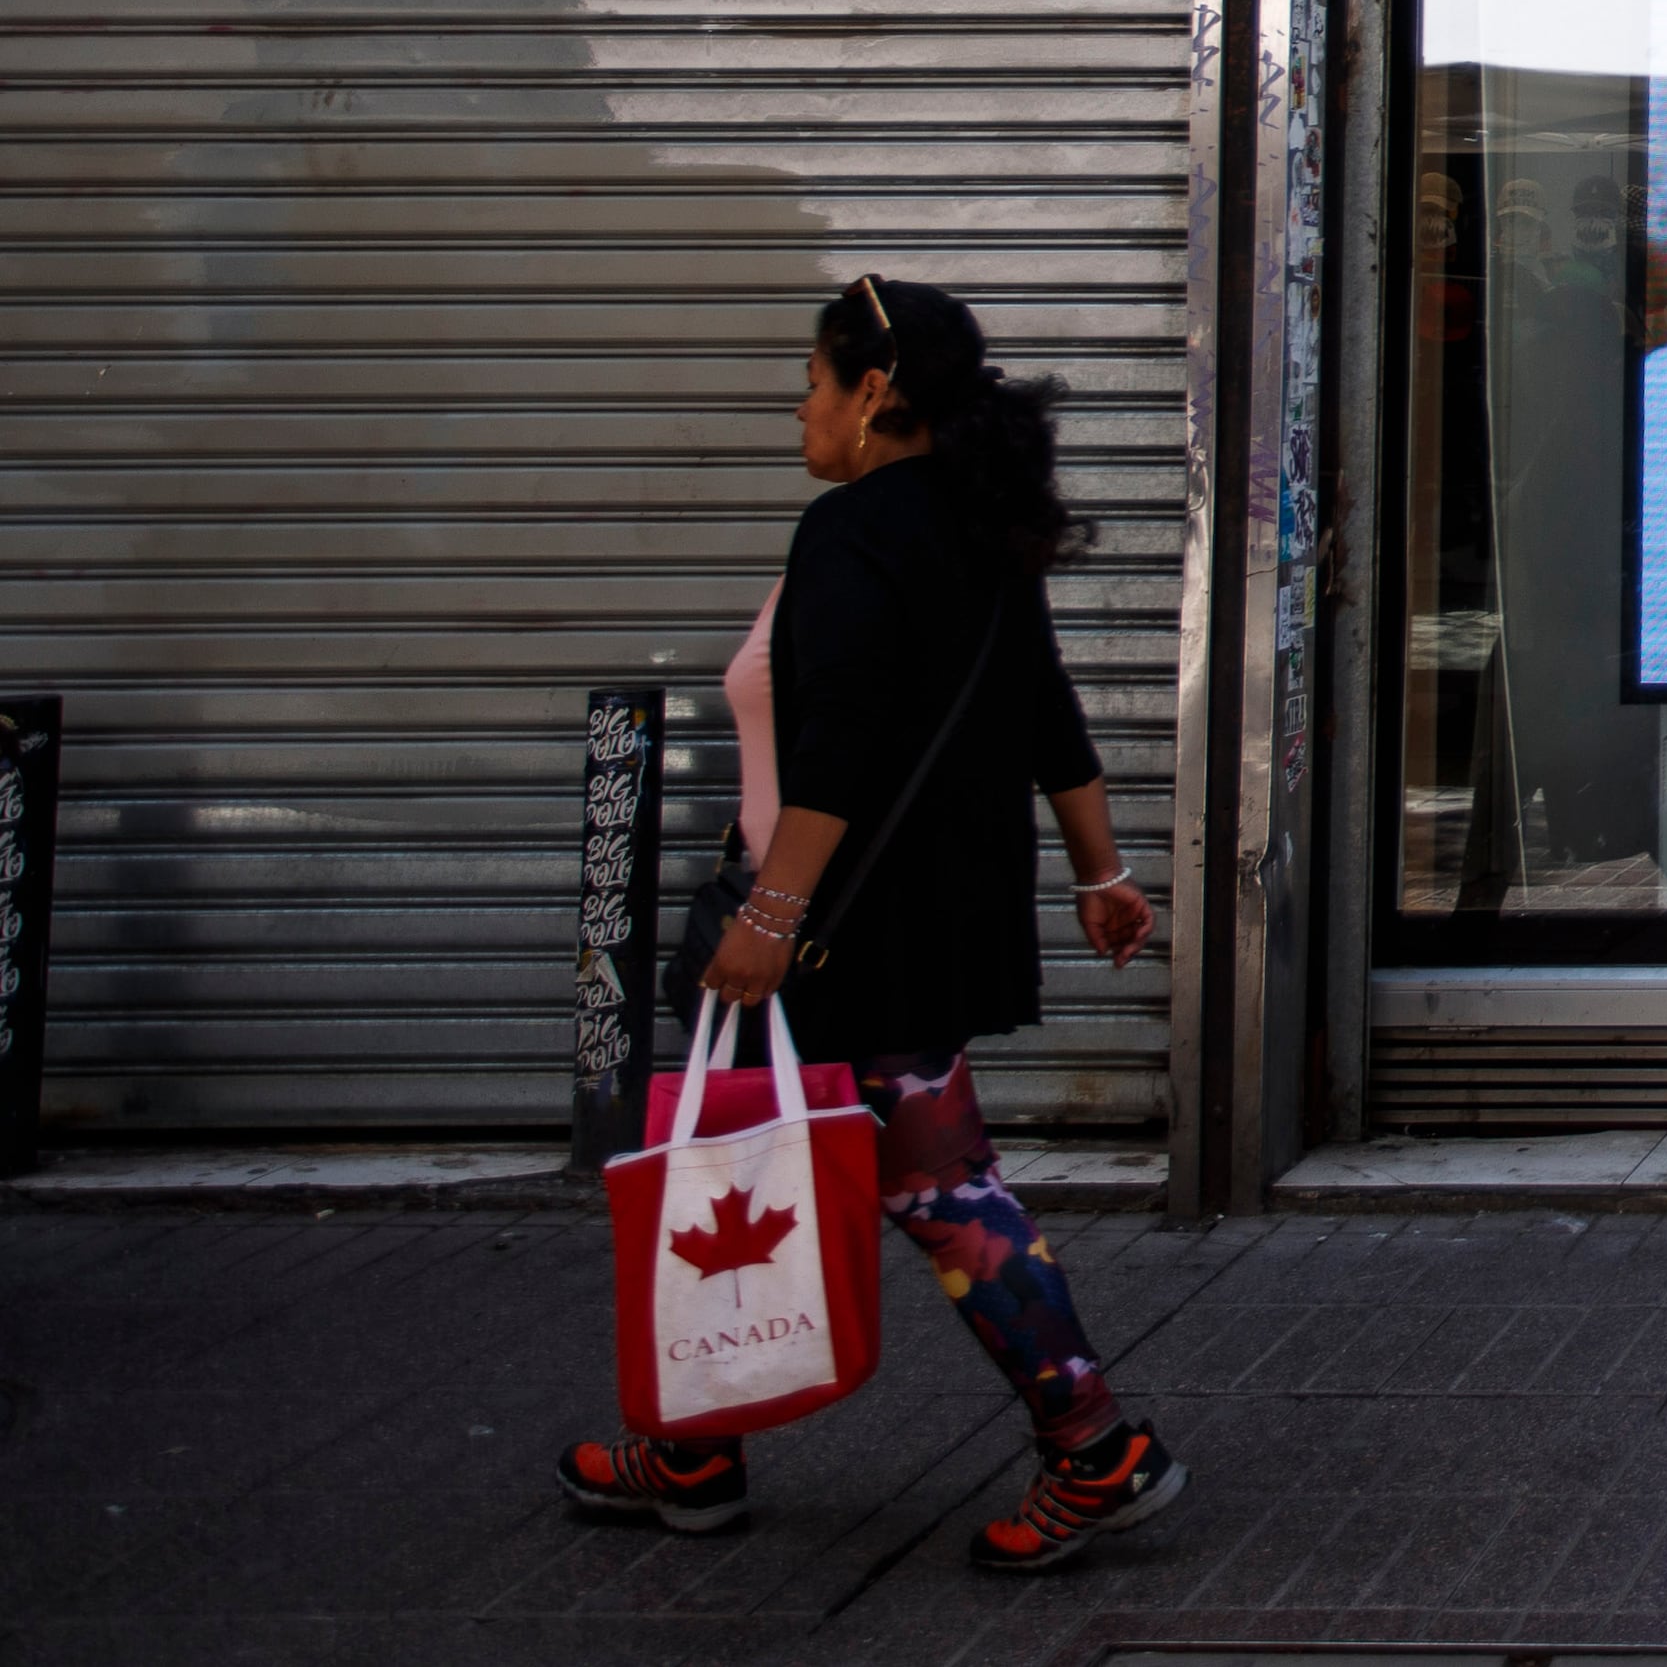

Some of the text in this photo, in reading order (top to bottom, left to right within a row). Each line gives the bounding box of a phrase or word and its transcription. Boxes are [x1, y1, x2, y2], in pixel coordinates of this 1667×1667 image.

[587, 729, 637, 761] POLO
[586, 796, 638, 828] POLO
[584, 856, 634, 887] POLO
[580, 915, 632, 947] POLO
[577, 1034, 631, 1071] POLO
[666, 1310, 817, 1363] CANADA
